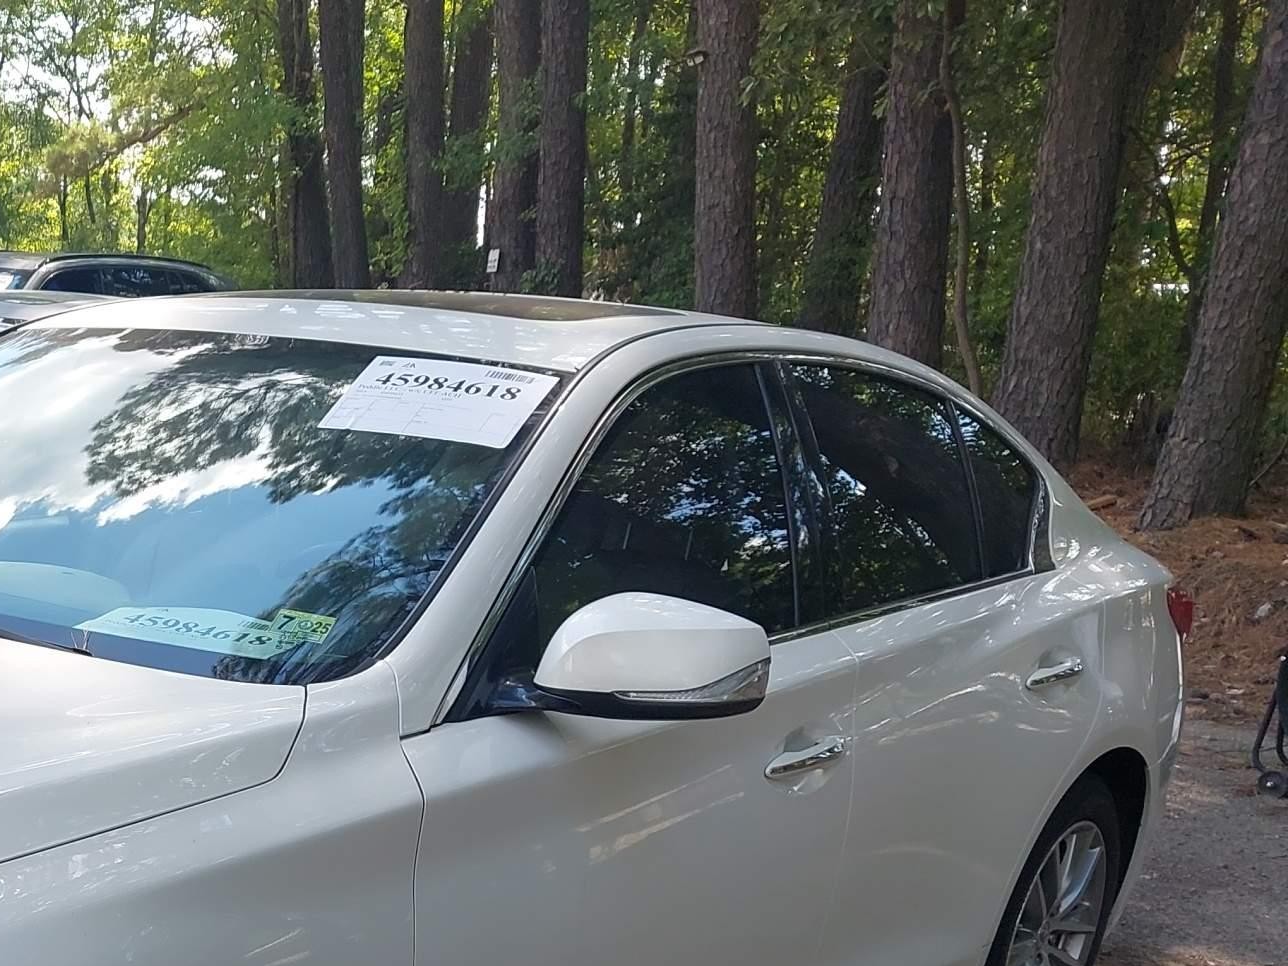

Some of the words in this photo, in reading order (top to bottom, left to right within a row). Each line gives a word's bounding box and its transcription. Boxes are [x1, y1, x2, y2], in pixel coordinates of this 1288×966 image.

[375, 372, 522, 401] 45984618
[123, 613, 273, 646] 45984618
[277, 614, 297, 630] 7
[310, 621, 333, 635] 25
